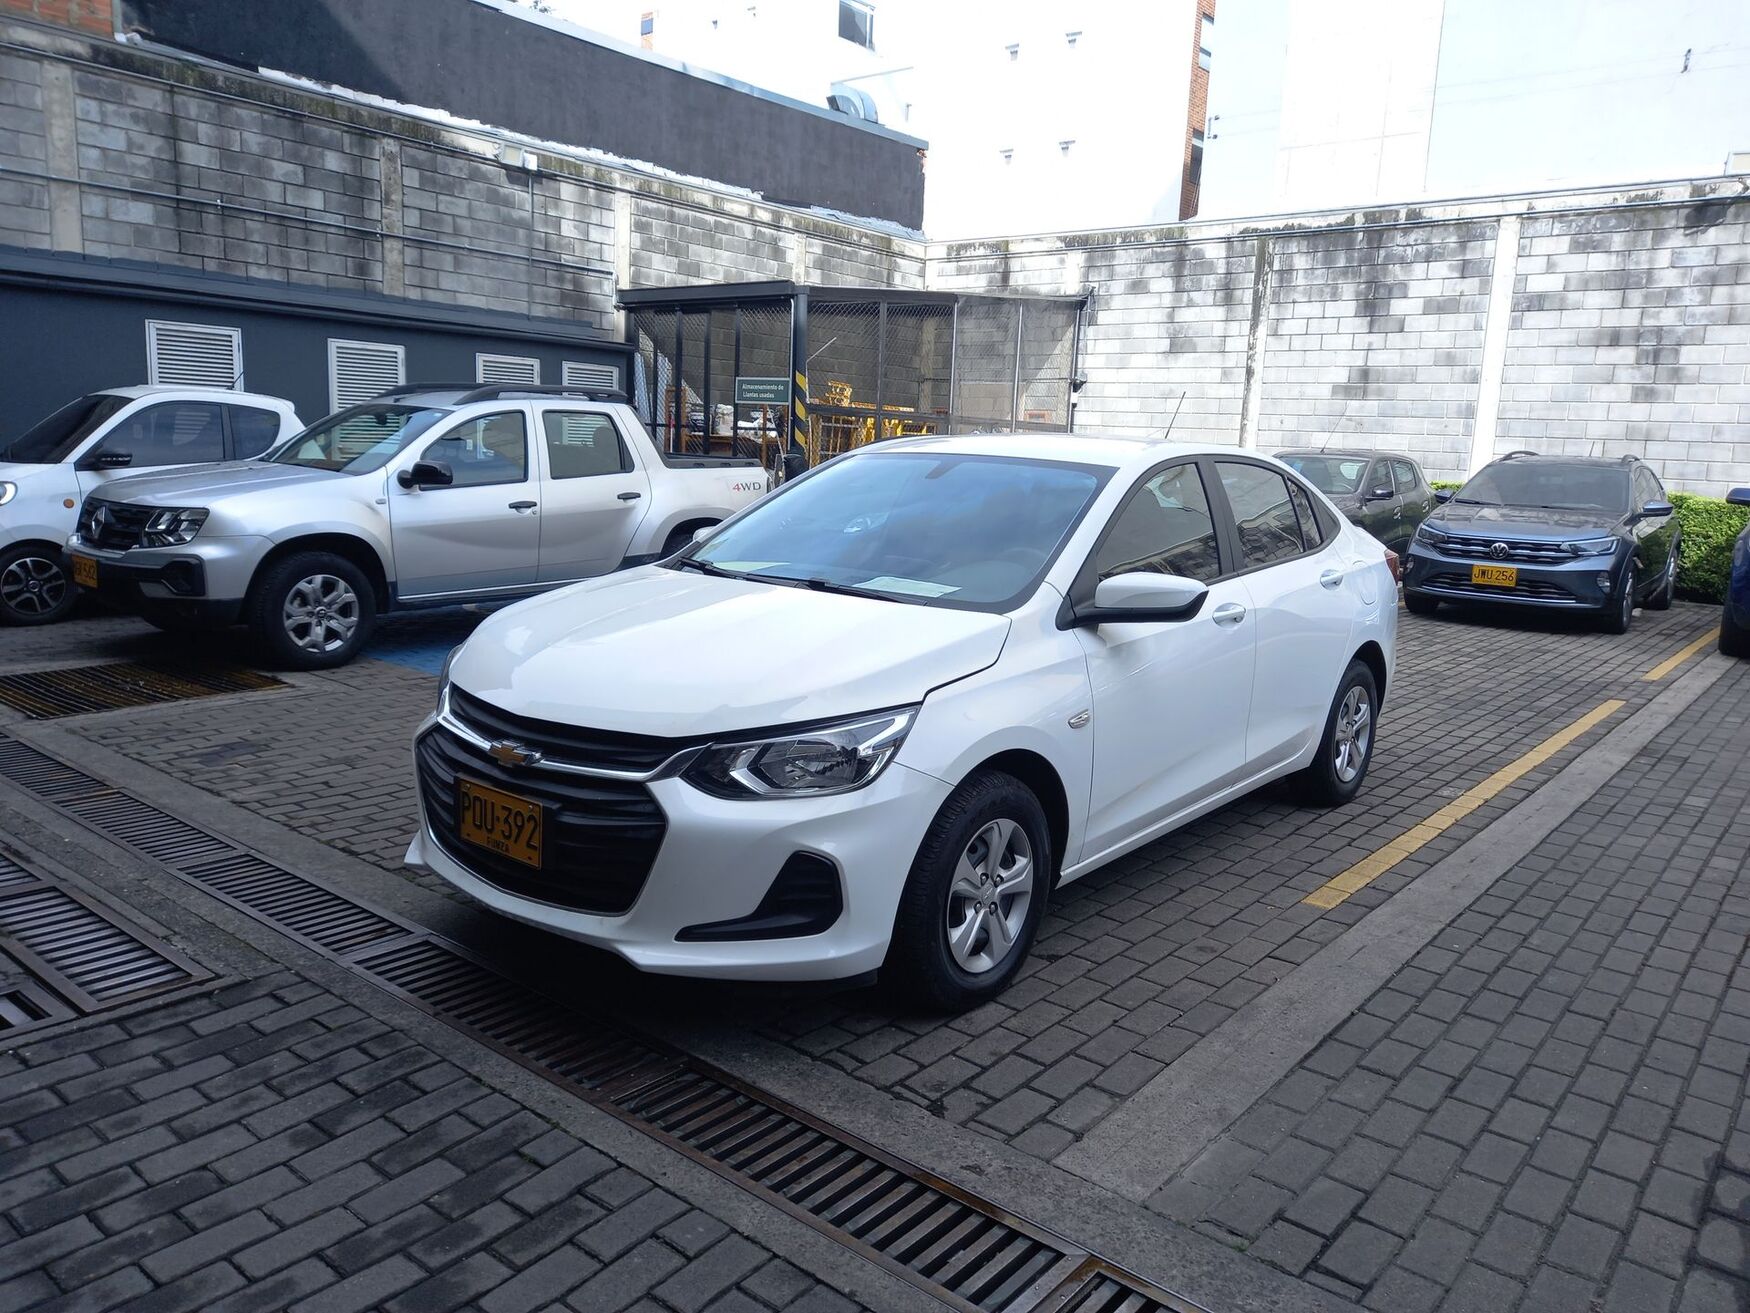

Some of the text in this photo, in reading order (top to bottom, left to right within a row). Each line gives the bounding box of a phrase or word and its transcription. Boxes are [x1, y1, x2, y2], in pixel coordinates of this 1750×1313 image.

[742, 383, 778, 391] Almacenamiento
[732, 481, 762, 492] 4WD
[1495, 570, 1514, 582] 256
